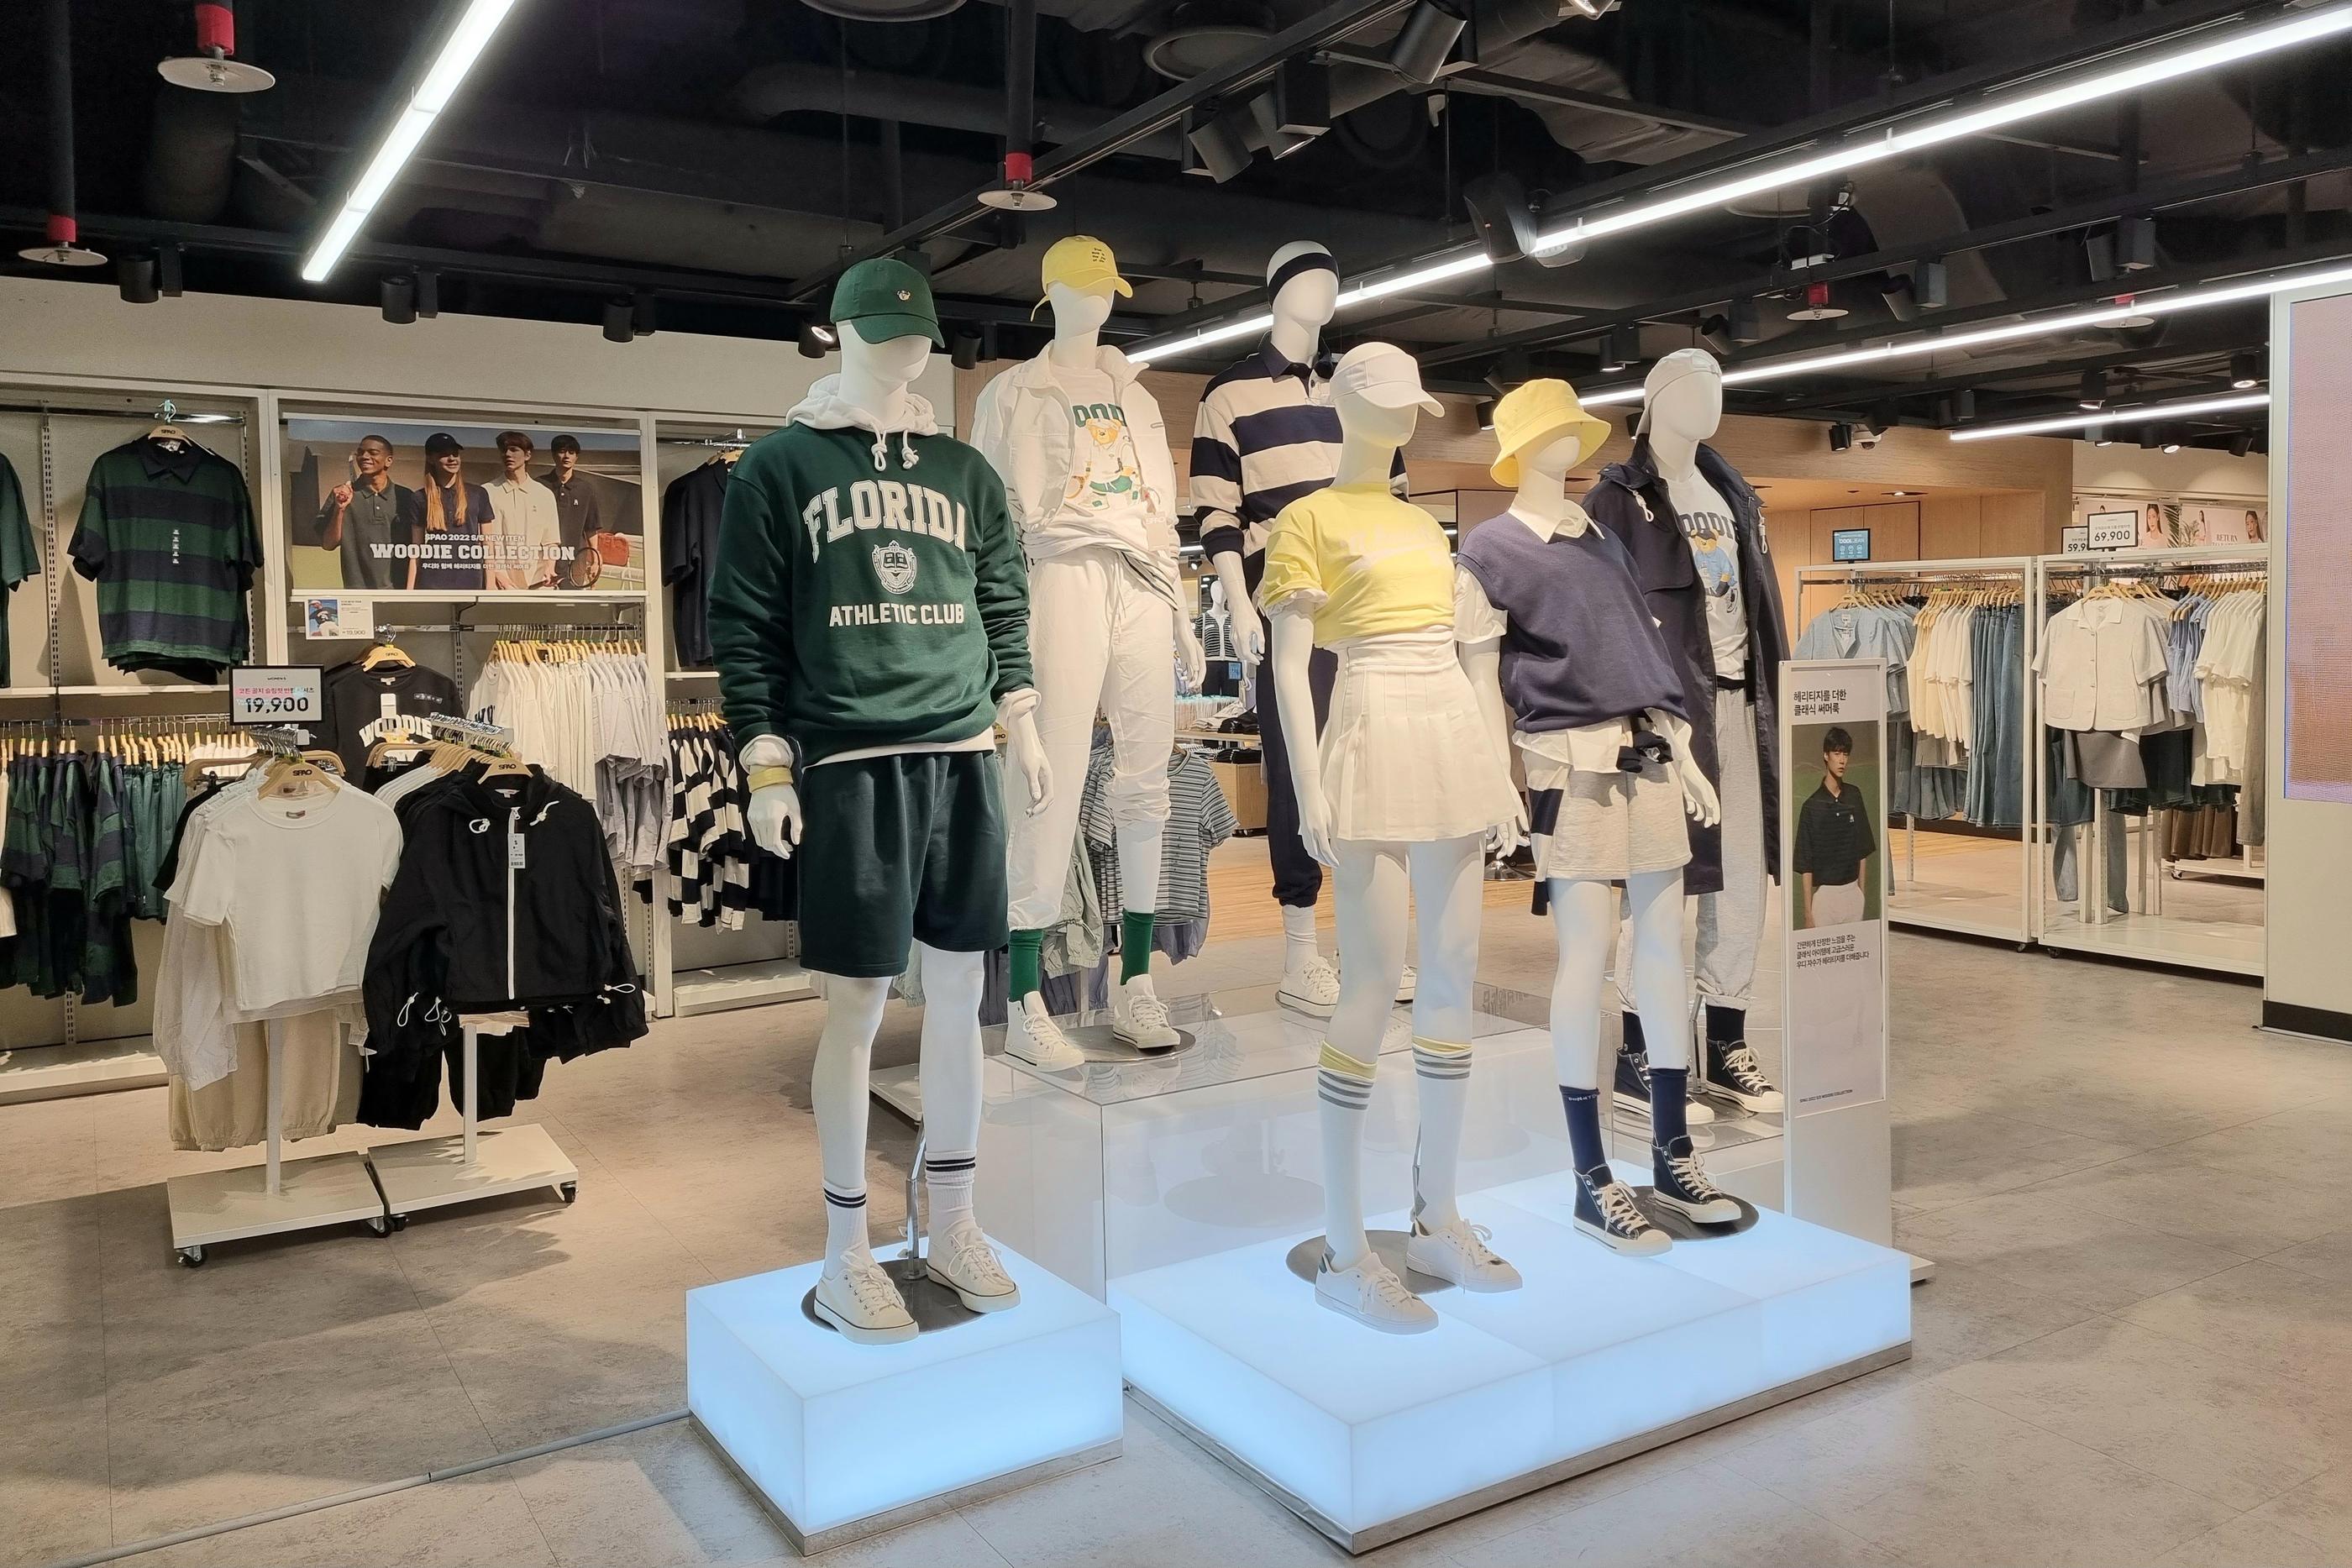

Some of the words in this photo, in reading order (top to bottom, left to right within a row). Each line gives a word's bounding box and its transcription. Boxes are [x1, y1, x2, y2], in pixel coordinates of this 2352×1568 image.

[2094, 531, 2130, 542] 69,900
[370, 543, 453, 559] WOODIE
[458, 544, 575, 561] COLLECTION
[2067, 543, 2087, 552] 59,9
[829, 602, 916, 627] ATHLETIC
[920, 603, 964, 625] CLUB
[1793, 690, 1830, 702] 헤리티지를
[1832, 689, 1846, 700] 더한
[245, 696, 309, 714] 19,900
[1794, 703, 1816, 716] 클래식
[1818, 702, 1840, 715] 써머룩
